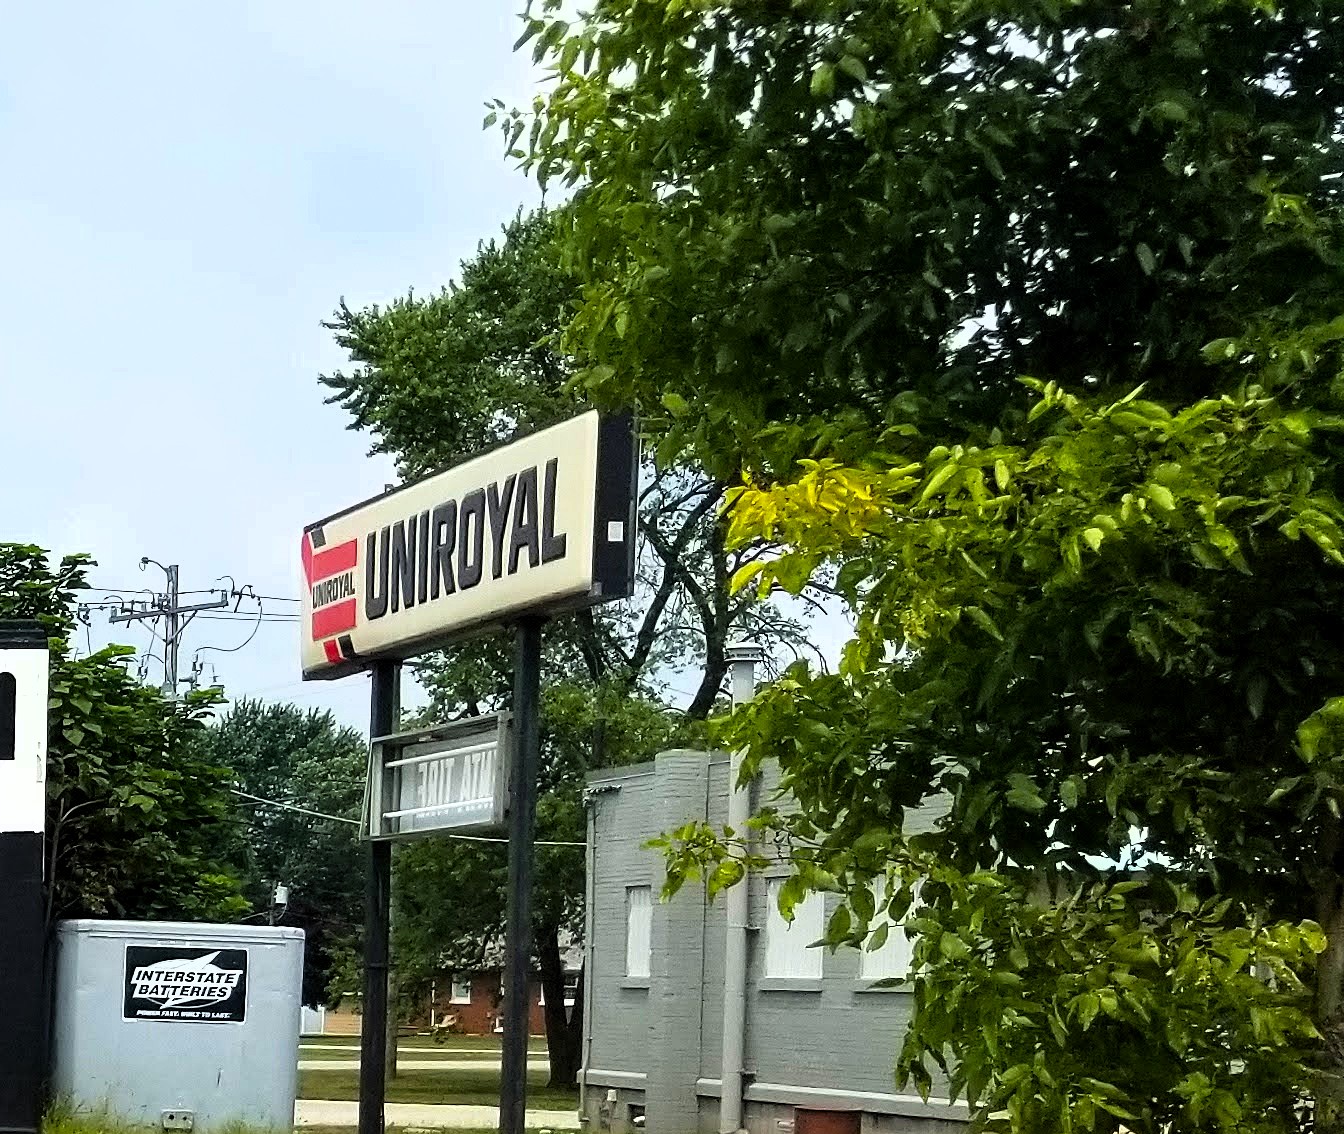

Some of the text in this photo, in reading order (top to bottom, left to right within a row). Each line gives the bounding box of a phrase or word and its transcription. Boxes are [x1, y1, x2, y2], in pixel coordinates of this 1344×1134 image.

[365, 457, 567, 621] UNIROYAL
[312, 572, 355, 609] UNIROYAL
[135, 969, 237, 985] INTERSTATE
[138, 984, 229, 998] BATTERIES
